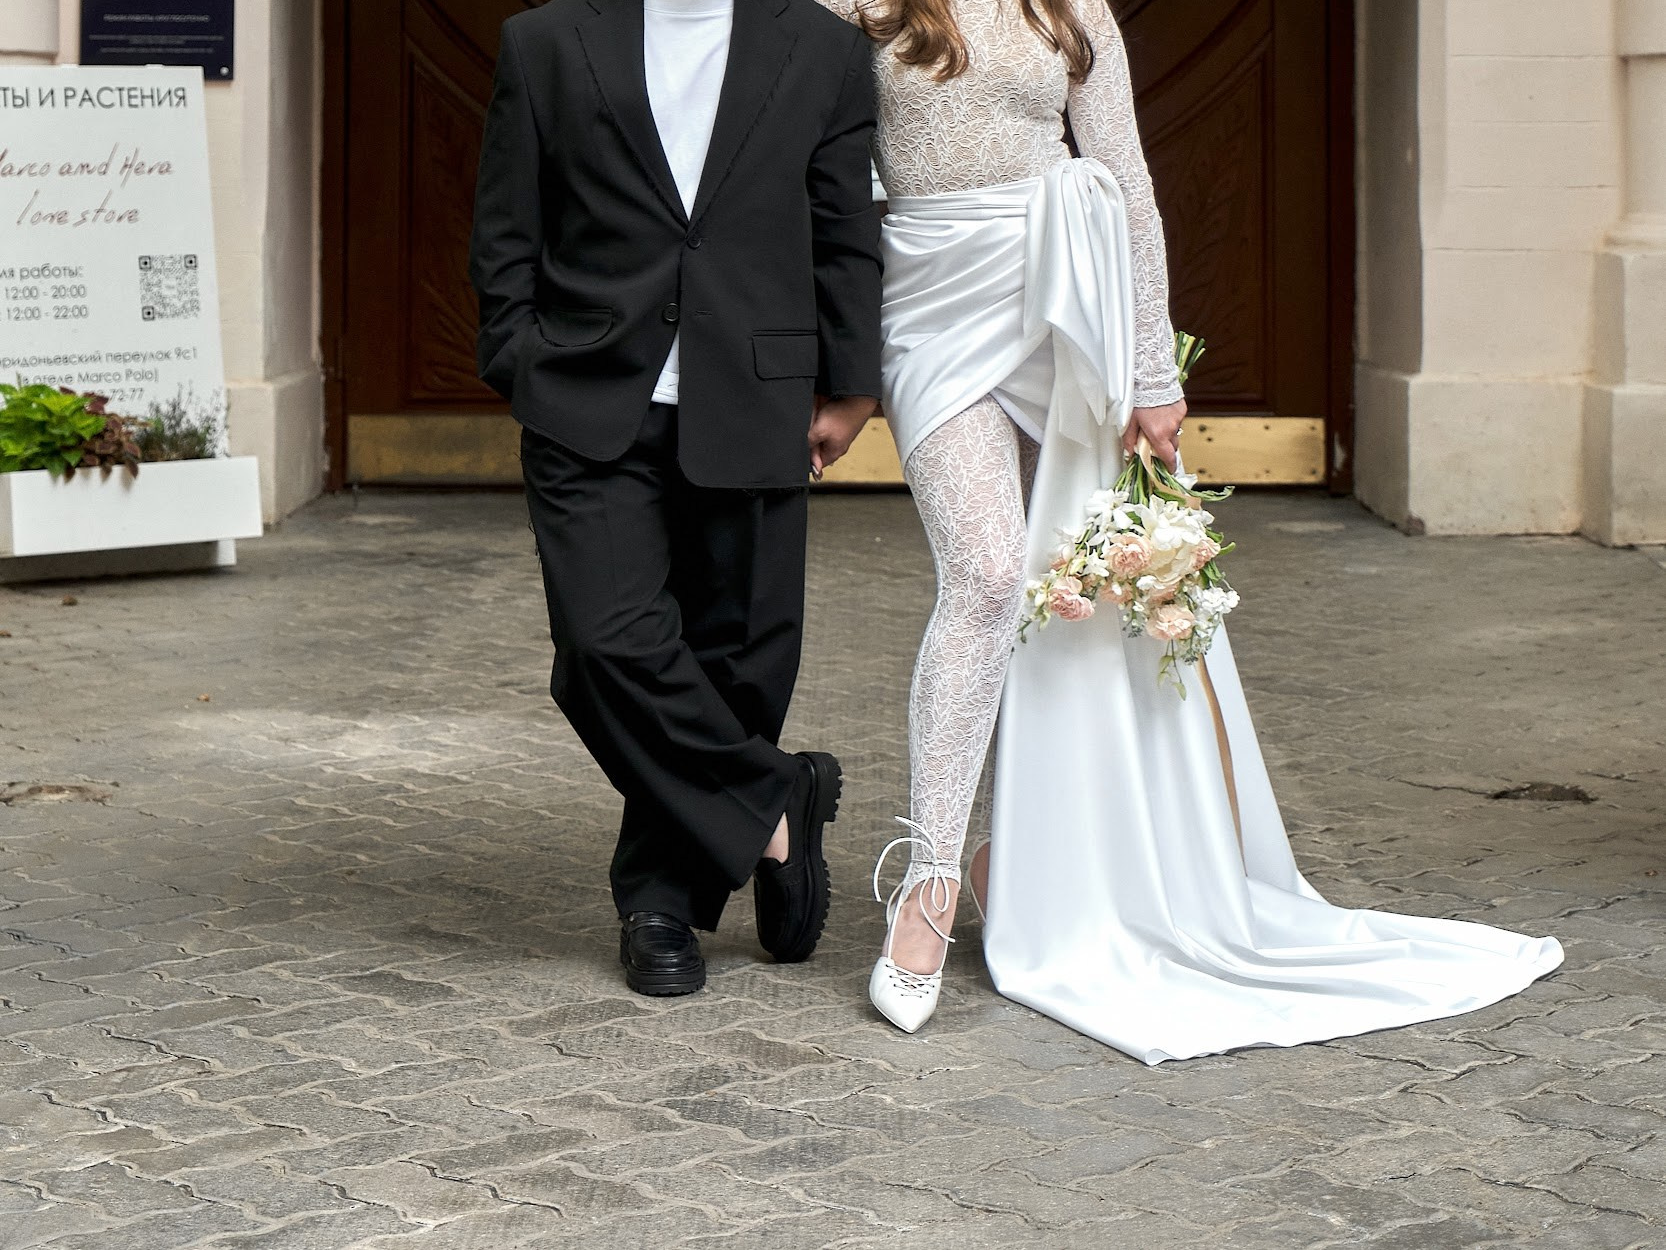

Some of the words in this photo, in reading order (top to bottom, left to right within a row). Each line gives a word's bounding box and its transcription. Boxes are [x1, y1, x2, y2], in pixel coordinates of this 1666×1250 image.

[0, 86, 30, 109] ТЫ
[38, 86, 56, 109] И
[63, 86, 188, 109] РАСТЕНИЯ
[58, 141, 120, 177] and
[118, 146, 174, 190] Hera
[72, 188, 140, 227] store
[19, 262, 84, 281] работы:
[5, 286, 39, 301] 12:00
[51, 284, 87, 300] 20:00
[7, 306, 42, 322] 12:00
[53, 305, 89, 321] 22:00
[0, 349, 102, 369] ридоньевский
[105, 349, 172, 365] переулок
[77, 369, 122, 384] Marco
